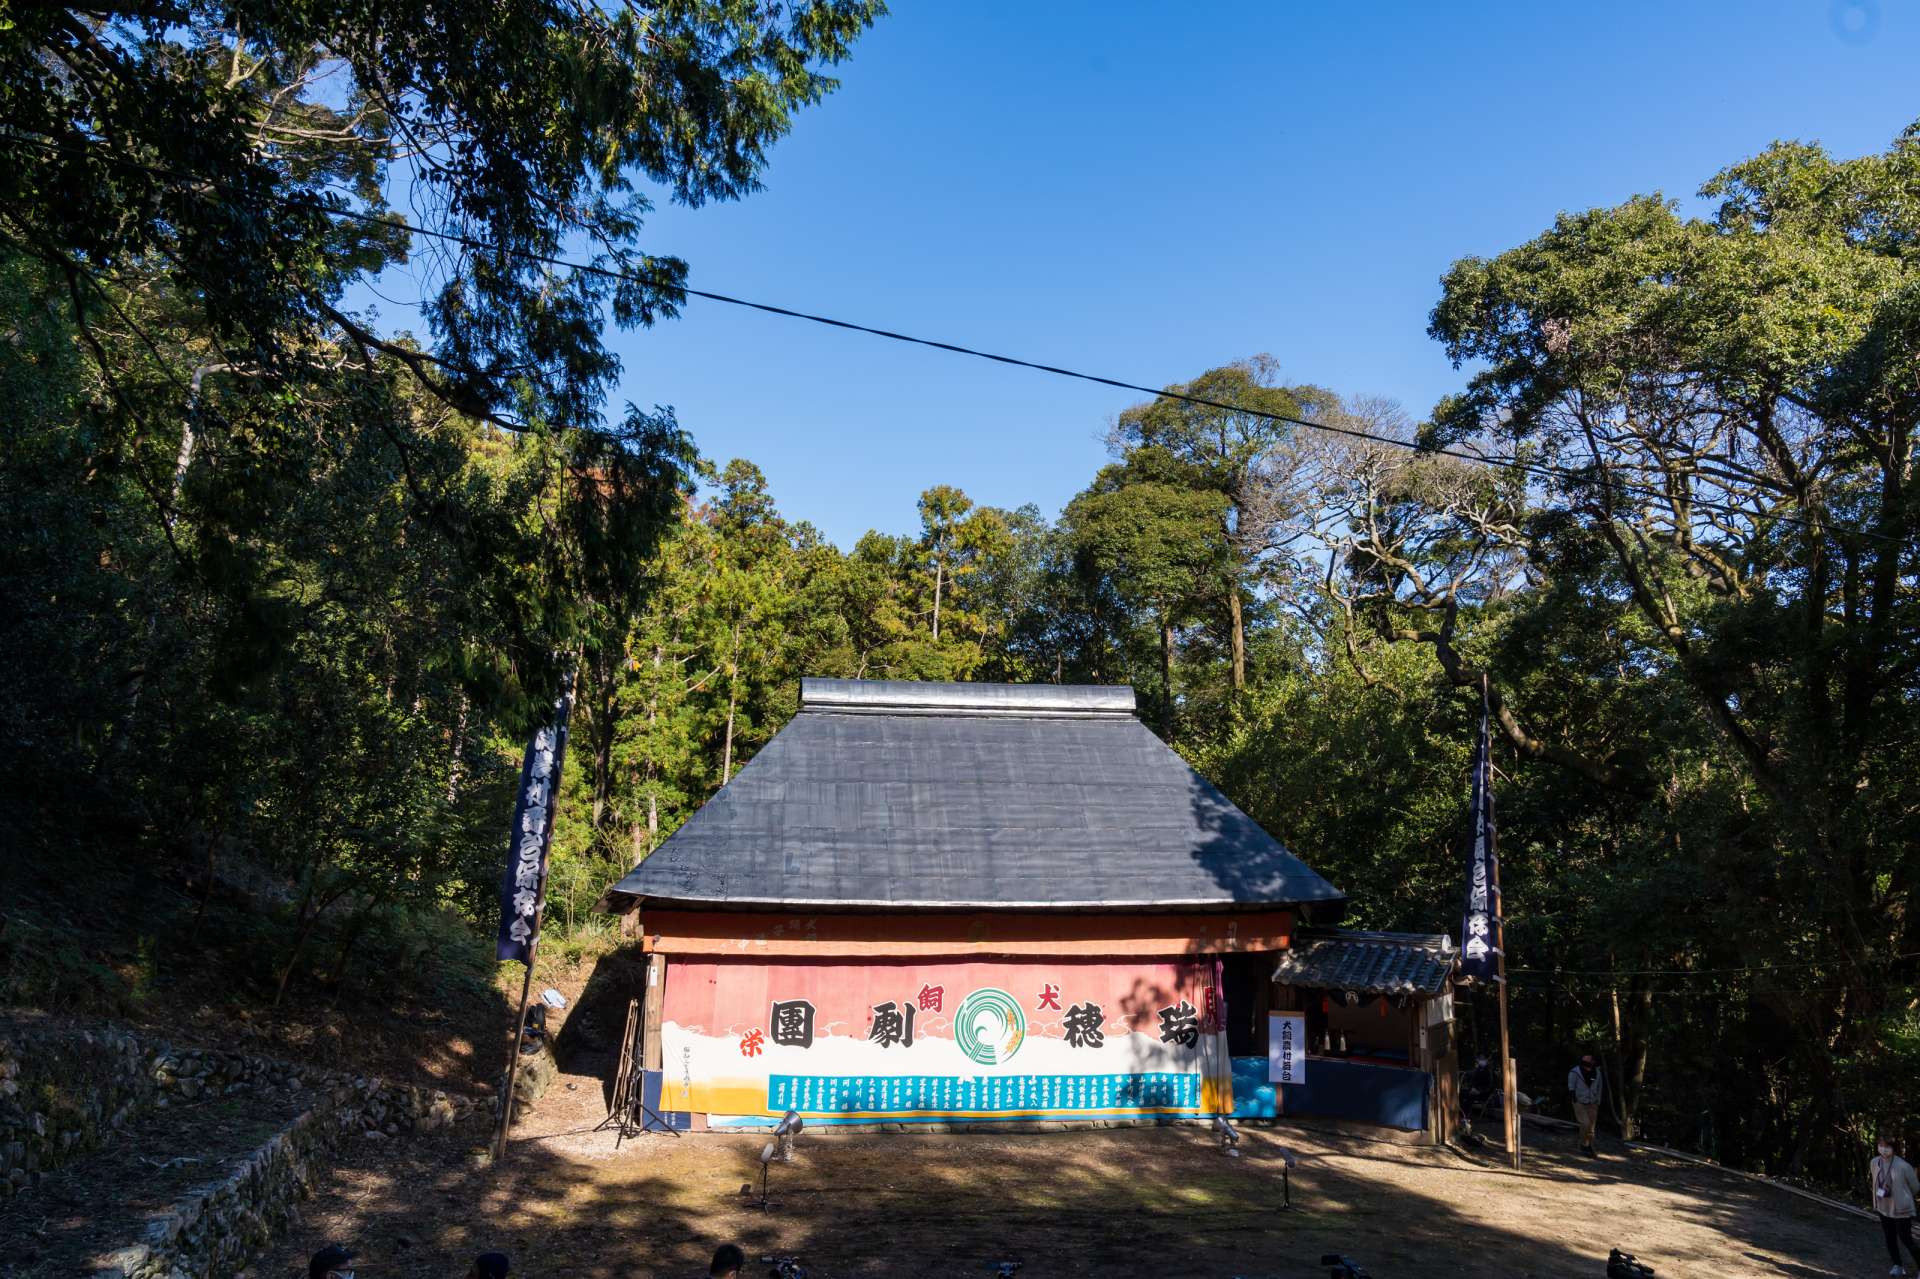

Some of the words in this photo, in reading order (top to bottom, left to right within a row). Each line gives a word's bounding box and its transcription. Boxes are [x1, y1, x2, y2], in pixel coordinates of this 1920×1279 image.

[918, 983, 945, 1013] 飼
[1037, 983, 1062, 1011] 犬
[739, 1028, 765, 1058] 栄
